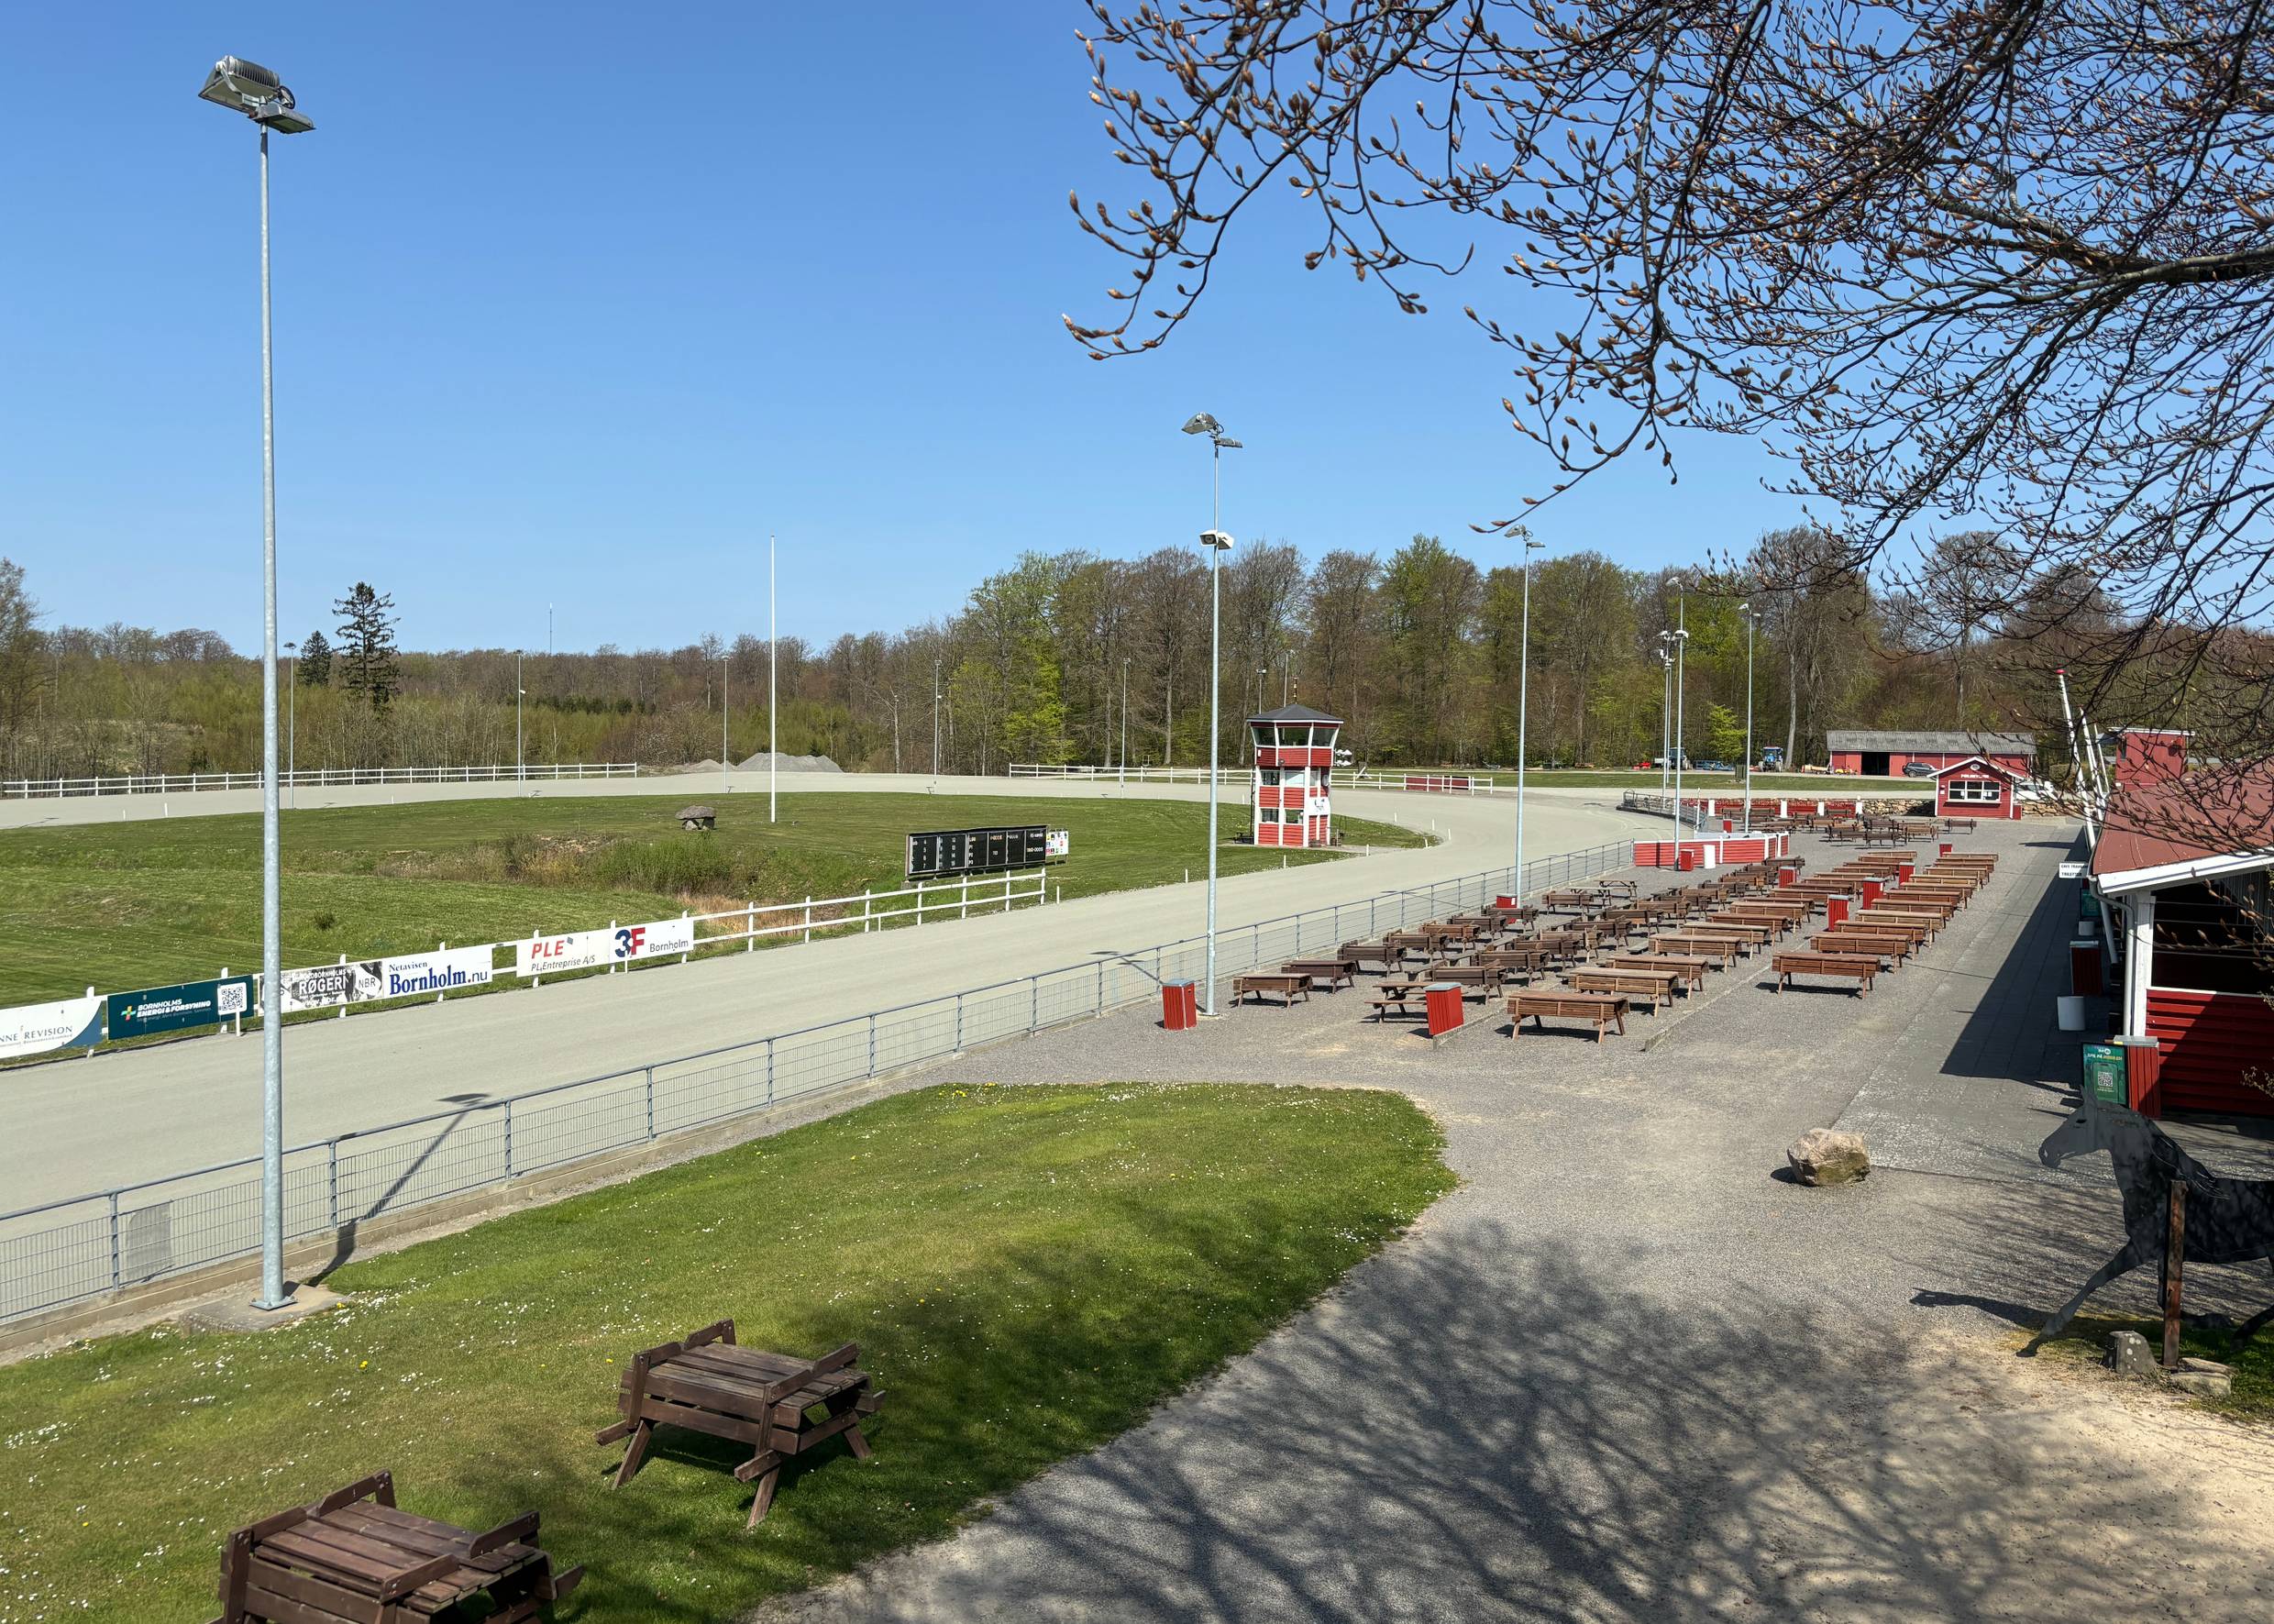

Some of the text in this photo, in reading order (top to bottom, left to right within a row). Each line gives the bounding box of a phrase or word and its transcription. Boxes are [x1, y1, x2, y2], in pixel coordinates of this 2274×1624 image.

[531, 940, 565, 959] PLE
[614, 927, 646, 958] 3F
[649, 939, 689, 953] Bornholm
[389, 961, 428, 972] Netavisen
[582, 955, 596, 966] A/S
[299, 975, 347, 995] RØGERI
[359, 977, 376, 989] NBR
[389, 965, 488, 996] Bornholm.nu
[137, 1009, 164, 1018] ENERGI
[171, 1000, 212, 1012] FORSYNING
[138, 999, 182, 1011] BORNHOLMS
[24, 1026, 72, 1040] REVISION
